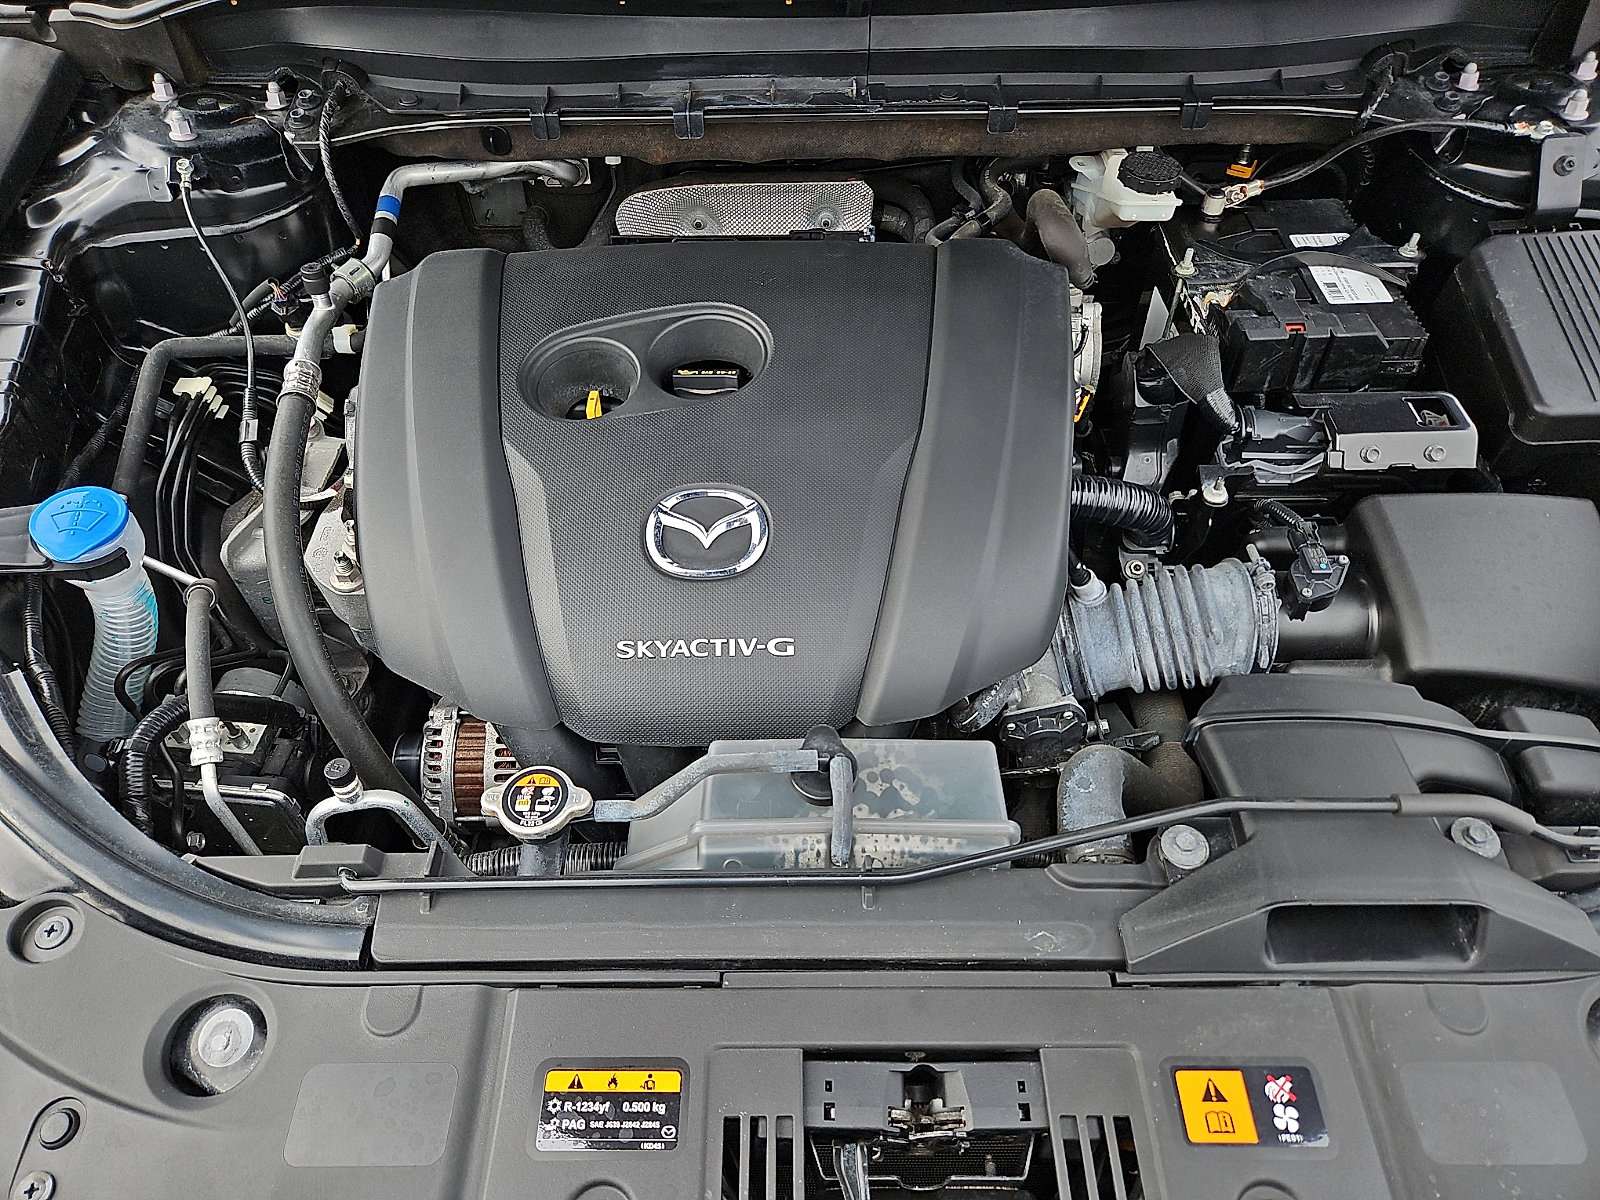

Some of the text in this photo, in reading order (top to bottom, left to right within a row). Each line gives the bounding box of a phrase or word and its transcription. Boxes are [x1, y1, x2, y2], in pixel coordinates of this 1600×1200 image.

[616, 637, 795, 659] SKYACTIV-G
[572, 793, 584, 803] 1.1
[563, 1101, 667, 1116] R-1234yf 0.500 kg
[561, 1119, 586, 1130] PAG
[589, 1120, 604, 1129] SAE
